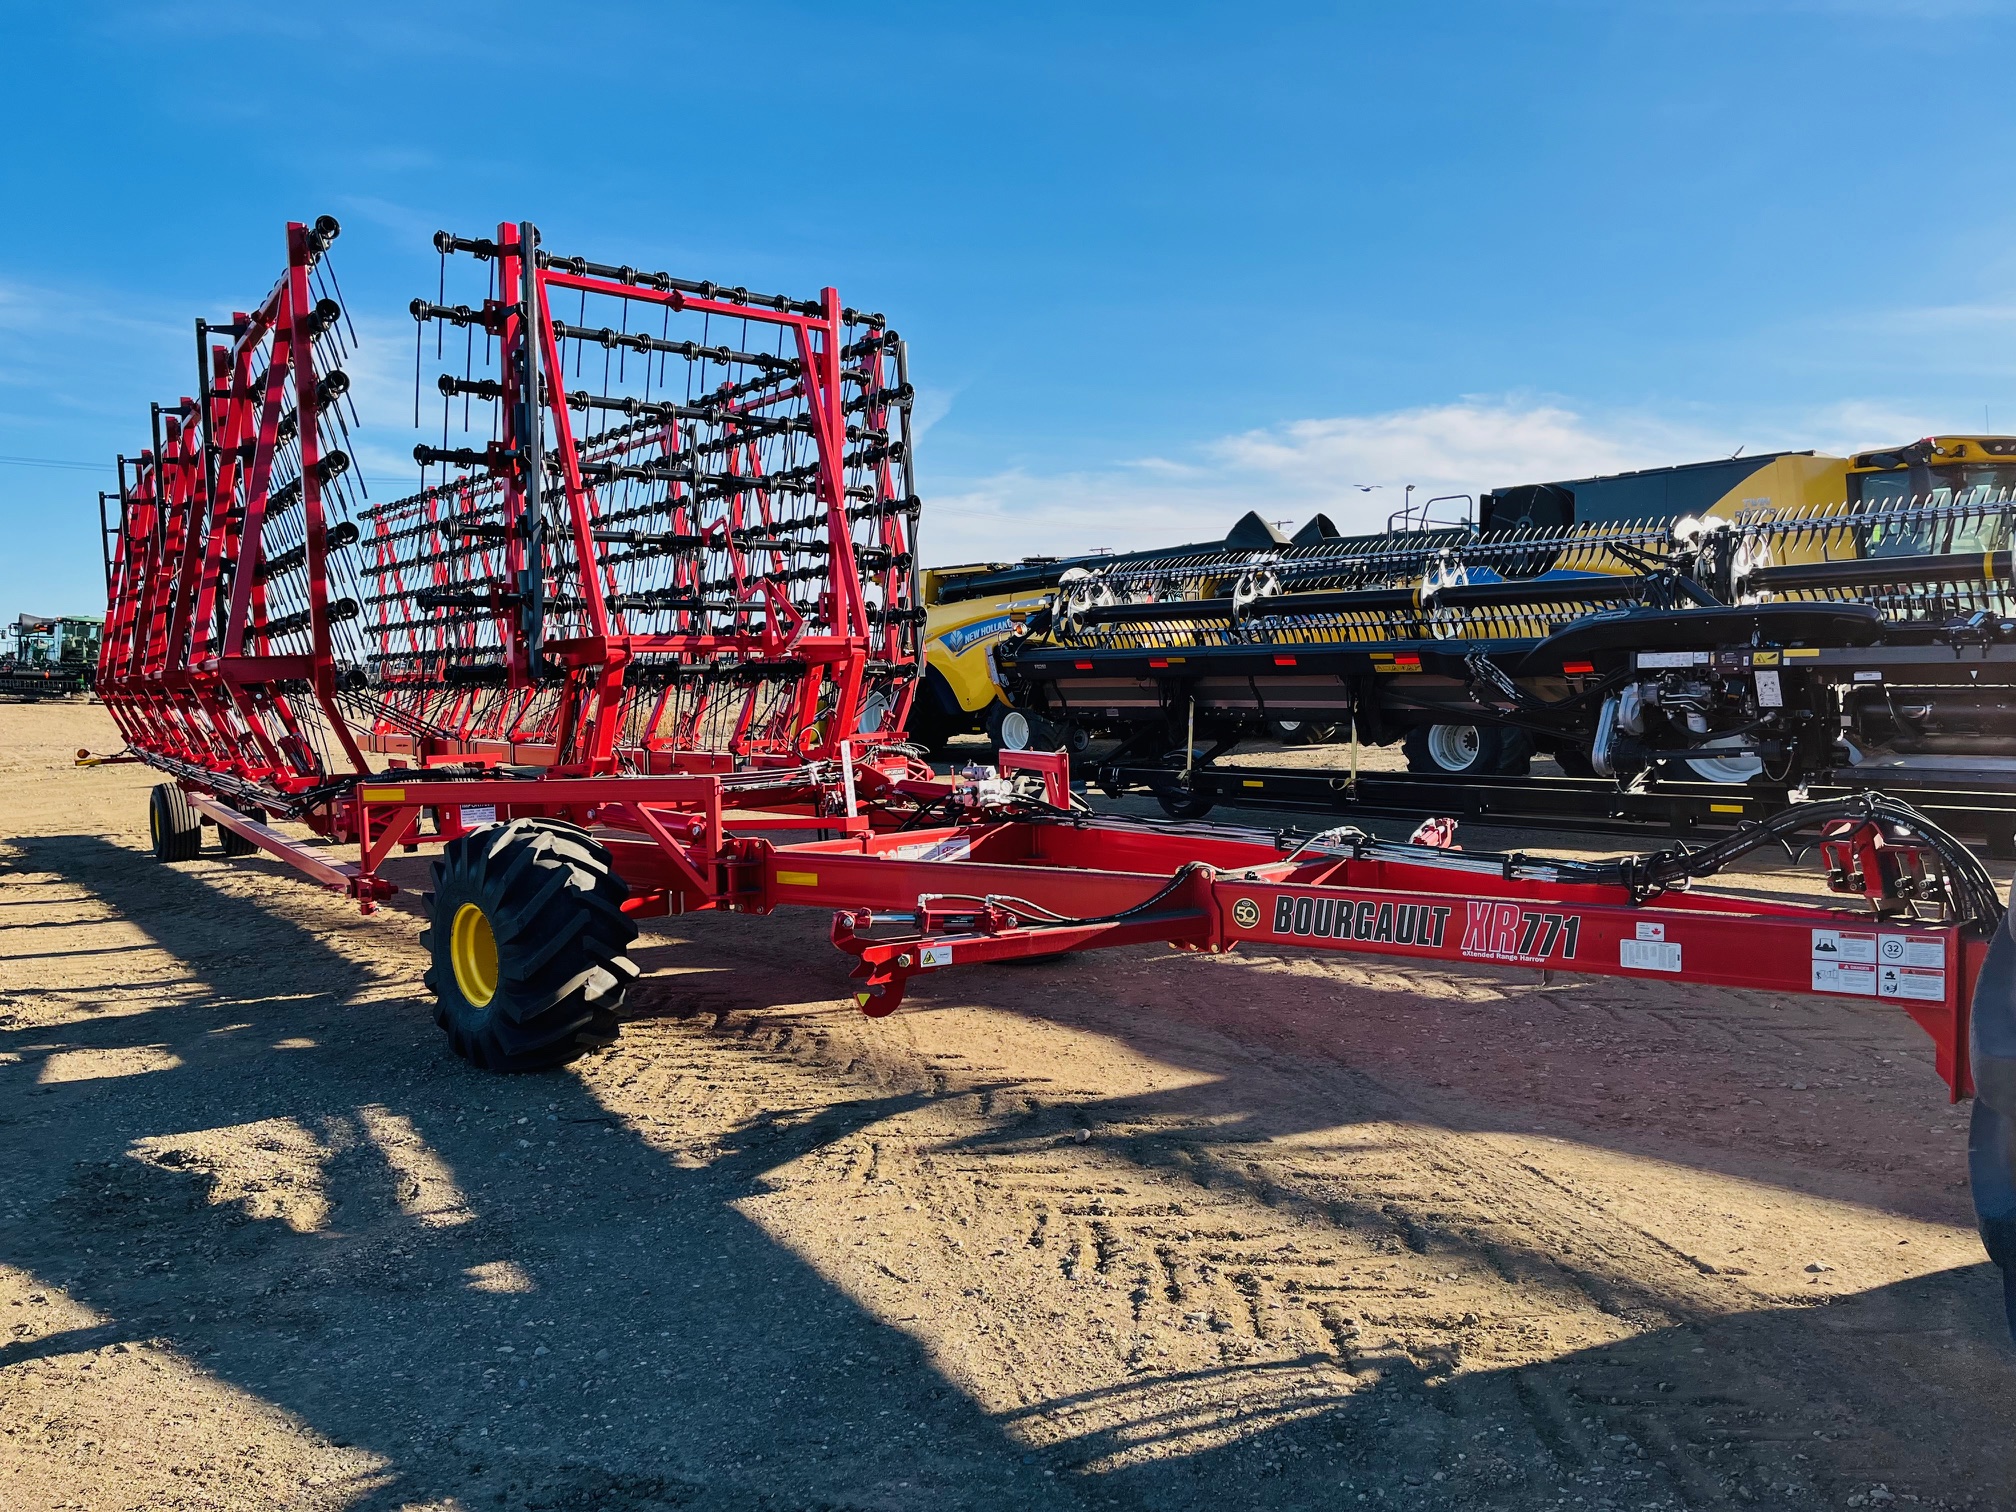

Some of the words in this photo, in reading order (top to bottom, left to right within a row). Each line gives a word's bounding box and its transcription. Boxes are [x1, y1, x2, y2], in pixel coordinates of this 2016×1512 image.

[1743, 496, 1771, 506] TWIN
[964, 629, 980, 644] NEW
[1236, 906, 1256, 923] 50
[1272, 895, 1452, 948] BOURGAULT
[1461, 901, 1582, 960] XR771
[1887, 944, 1899, 952] 32
[1462, 950, 1495, 958] eXtended
[1496, 953, 1518, 962] Range
